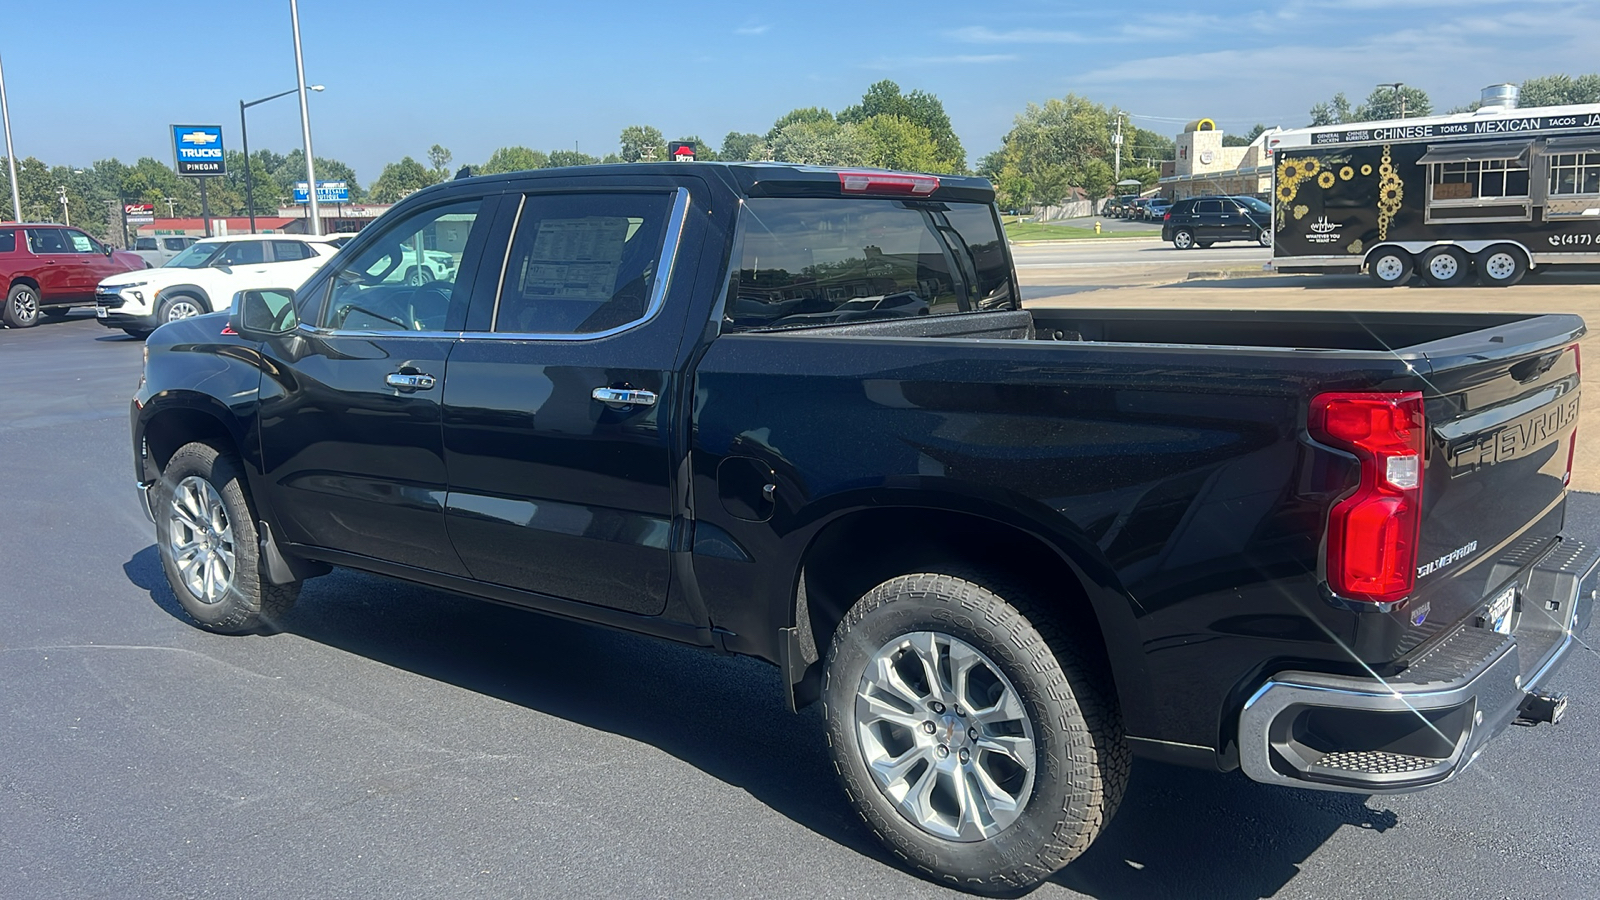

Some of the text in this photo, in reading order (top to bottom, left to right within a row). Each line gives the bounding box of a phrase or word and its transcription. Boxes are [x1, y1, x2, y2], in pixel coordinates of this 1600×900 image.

[1373, 126, 1433, 140] CHINESE
[1440, 124, 1467, 133] TORTAS
[1474, 118, 1541, 133] MEXICAN
[1548, 117, 1576, 126] TACOS
[180, 148, 222, 158] TRUCKS
[1561, 234, 1592, 245] (417)
[1451, 395, 1580, 479] CHEVROLET
[1416, 540, 1478, 579] SILVERADO
[931, 607, 1060, 781] GOODYEAR
